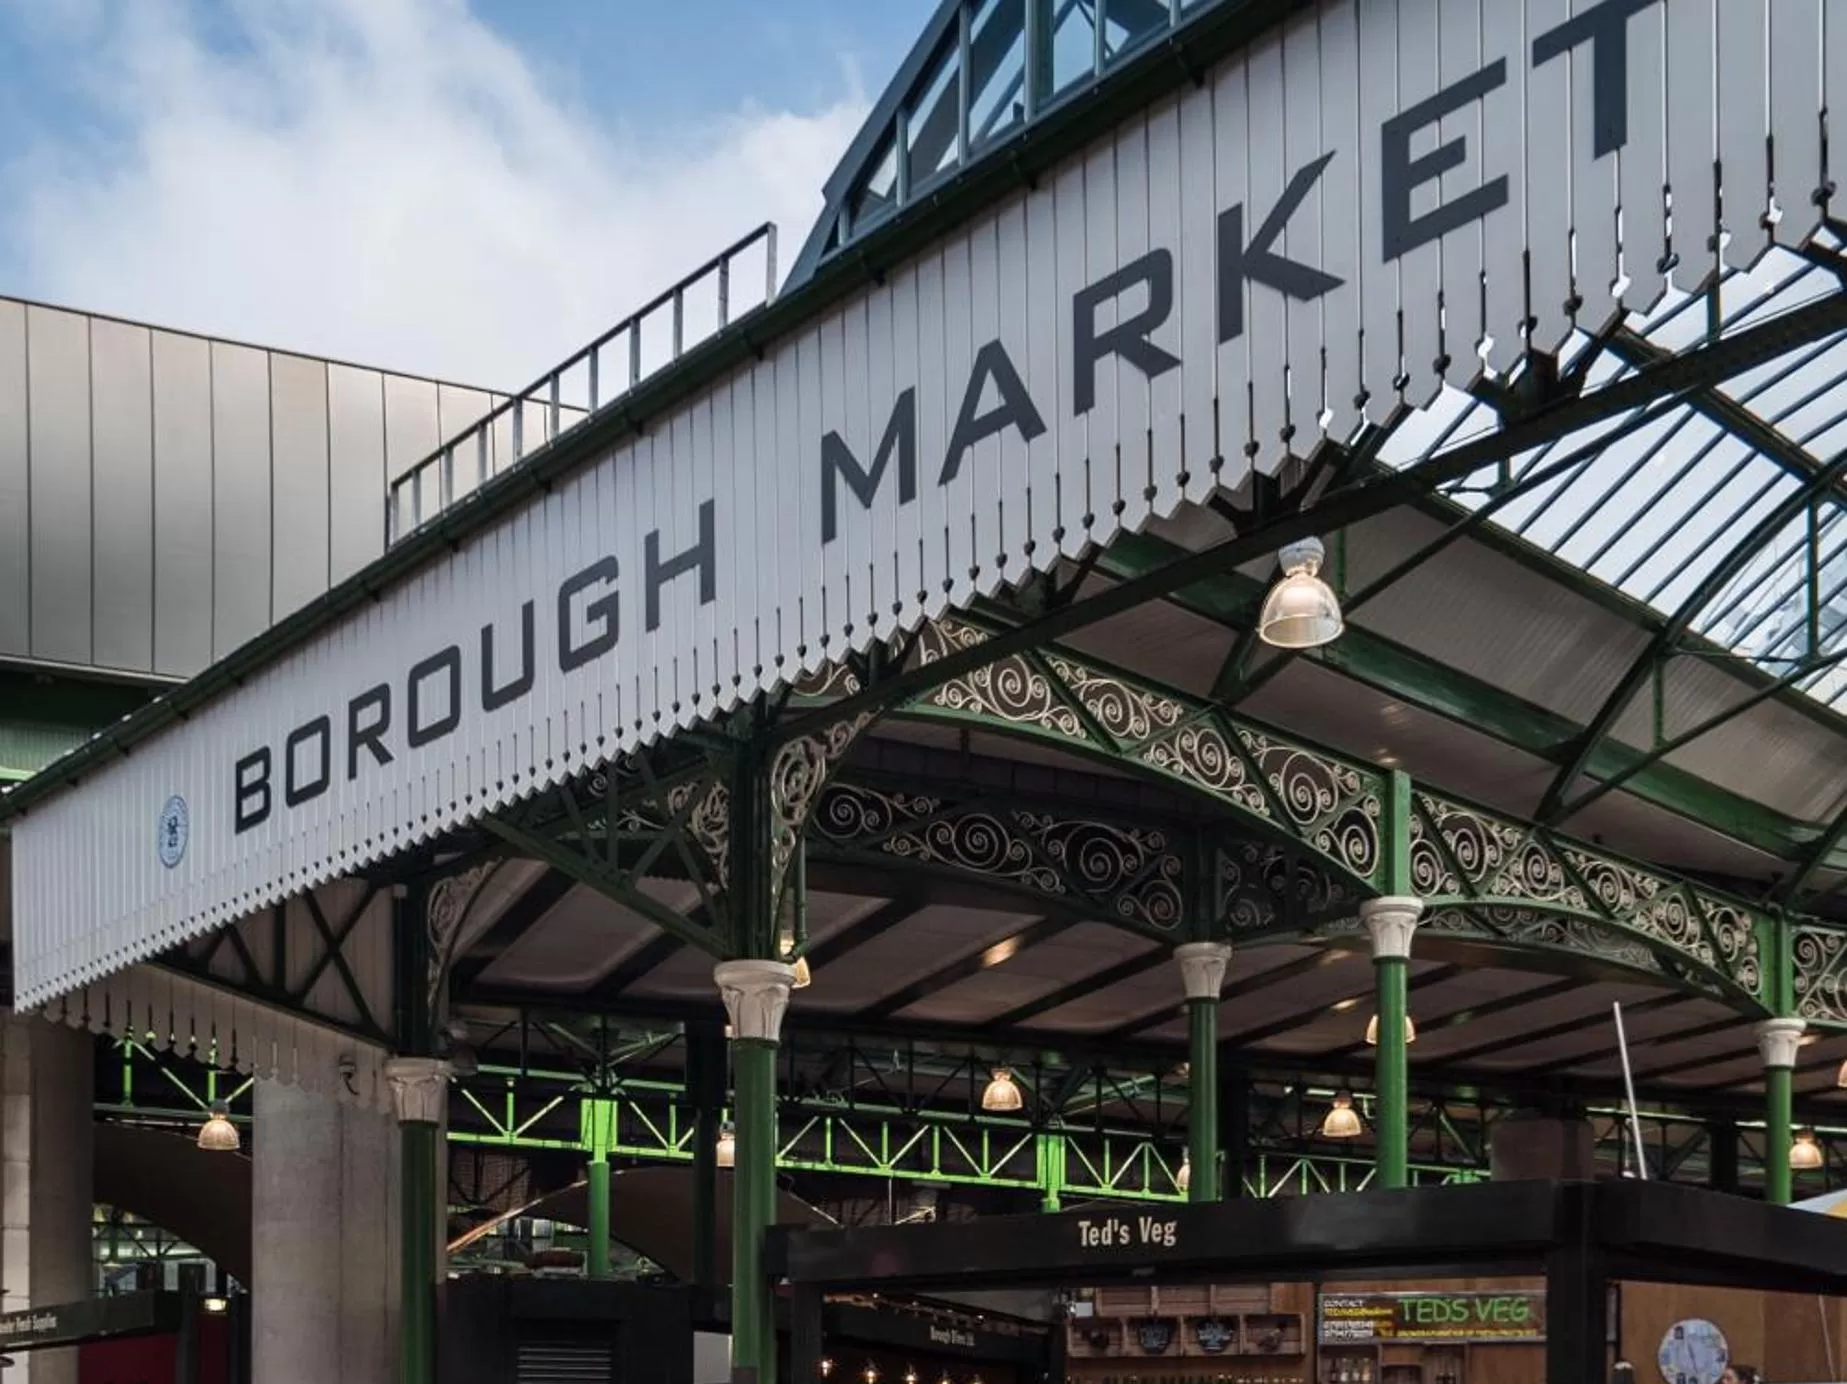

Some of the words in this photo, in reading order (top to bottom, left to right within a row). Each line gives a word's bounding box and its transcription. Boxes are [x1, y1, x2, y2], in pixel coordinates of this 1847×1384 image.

[235, 497, 716, 835] BOROUGH
[820, 0, 1659, 544] MARKET
[1078, 1218, 1130, 1247] Ted's
[1138, 1216, 1178, 1246] Veg
[1475, 1297, 1529, 1322] VEG
